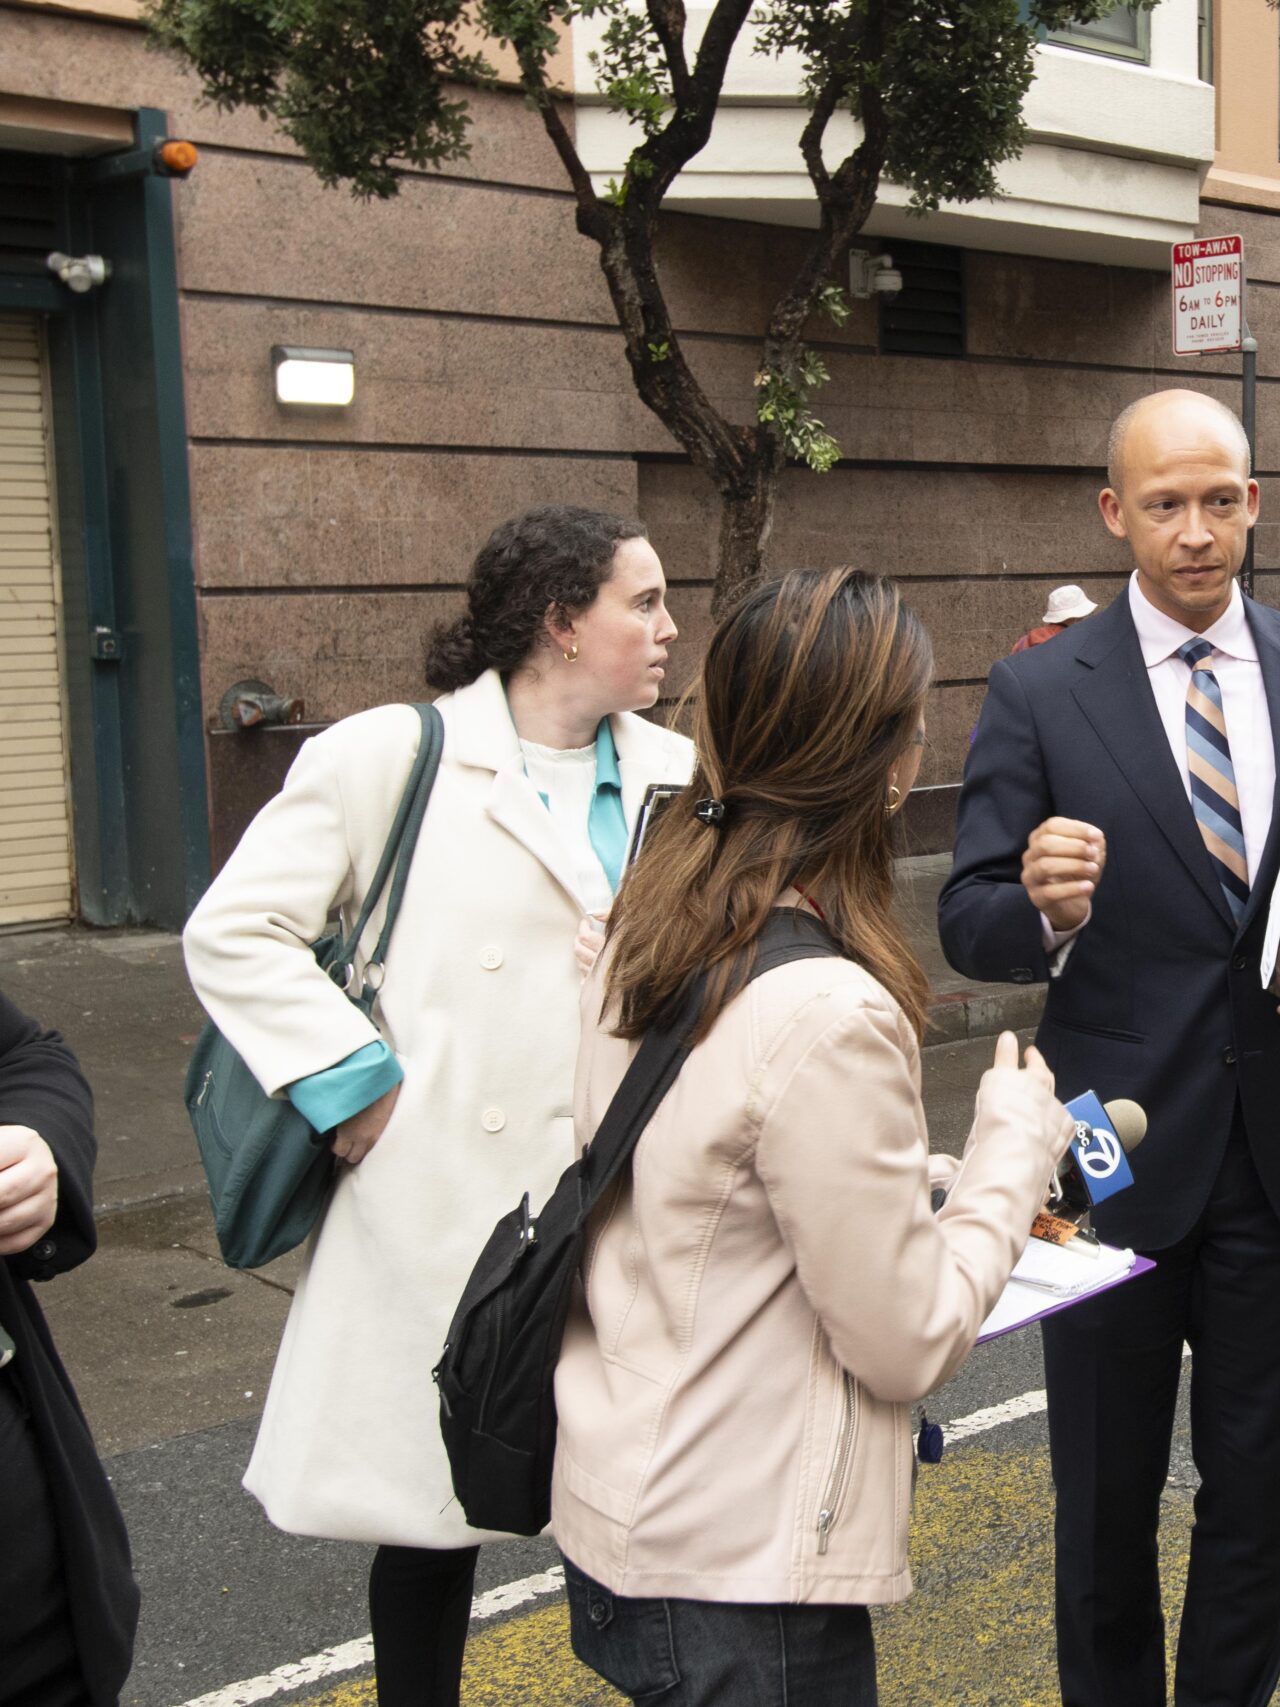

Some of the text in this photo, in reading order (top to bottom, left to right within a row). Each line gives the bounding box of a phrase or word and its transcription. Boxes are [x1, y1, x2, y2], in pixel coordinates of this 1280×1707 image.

[1178, 239, 1235, 258] TOW-AWAY
[1175, 262, 1238, 287] NO STOPPING
[1203, 297, 1211, 306] TO
[1191, 313, 1225, 330] DAILY
